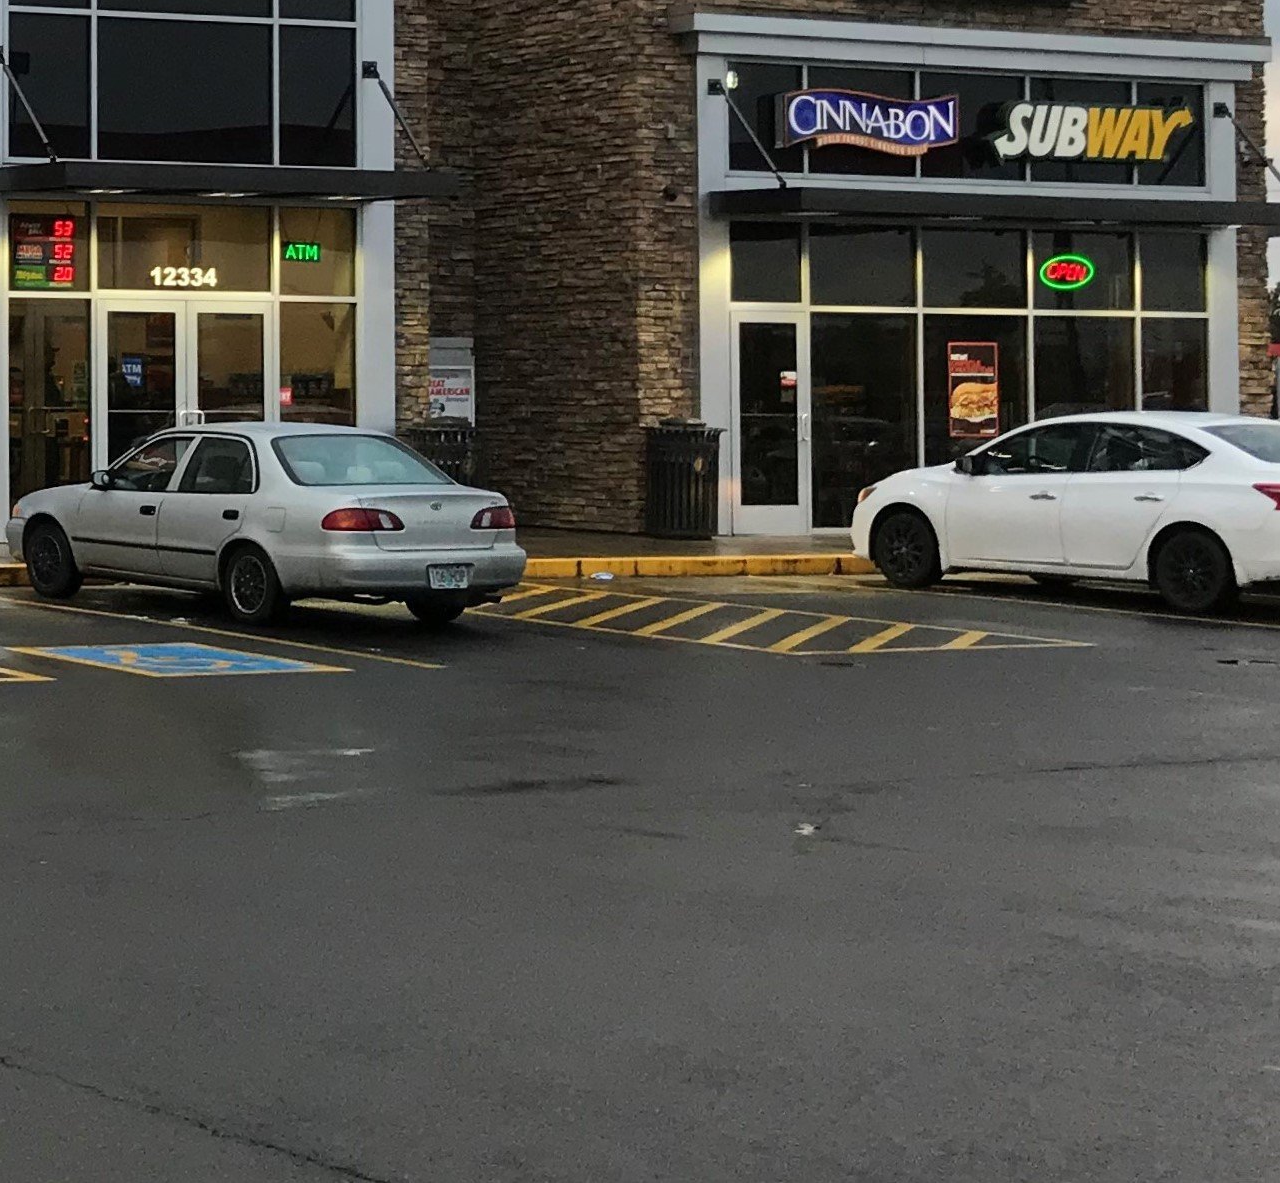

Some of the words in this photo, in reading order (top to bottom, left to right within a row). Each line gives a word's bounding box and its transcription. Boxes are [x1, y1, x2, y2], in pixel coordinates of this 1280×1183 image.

[789, 95, 955, 141] CINNABON
[994, 103, 1193, 161] SUBWAY
[54, 220, 74, 236] 53
[54, 244, 74, 259] 52
[285, 244, 318, 261] ATM
[150, 266, 218, 287] 12334
[1046, 263, 1087, 281] OPEN
